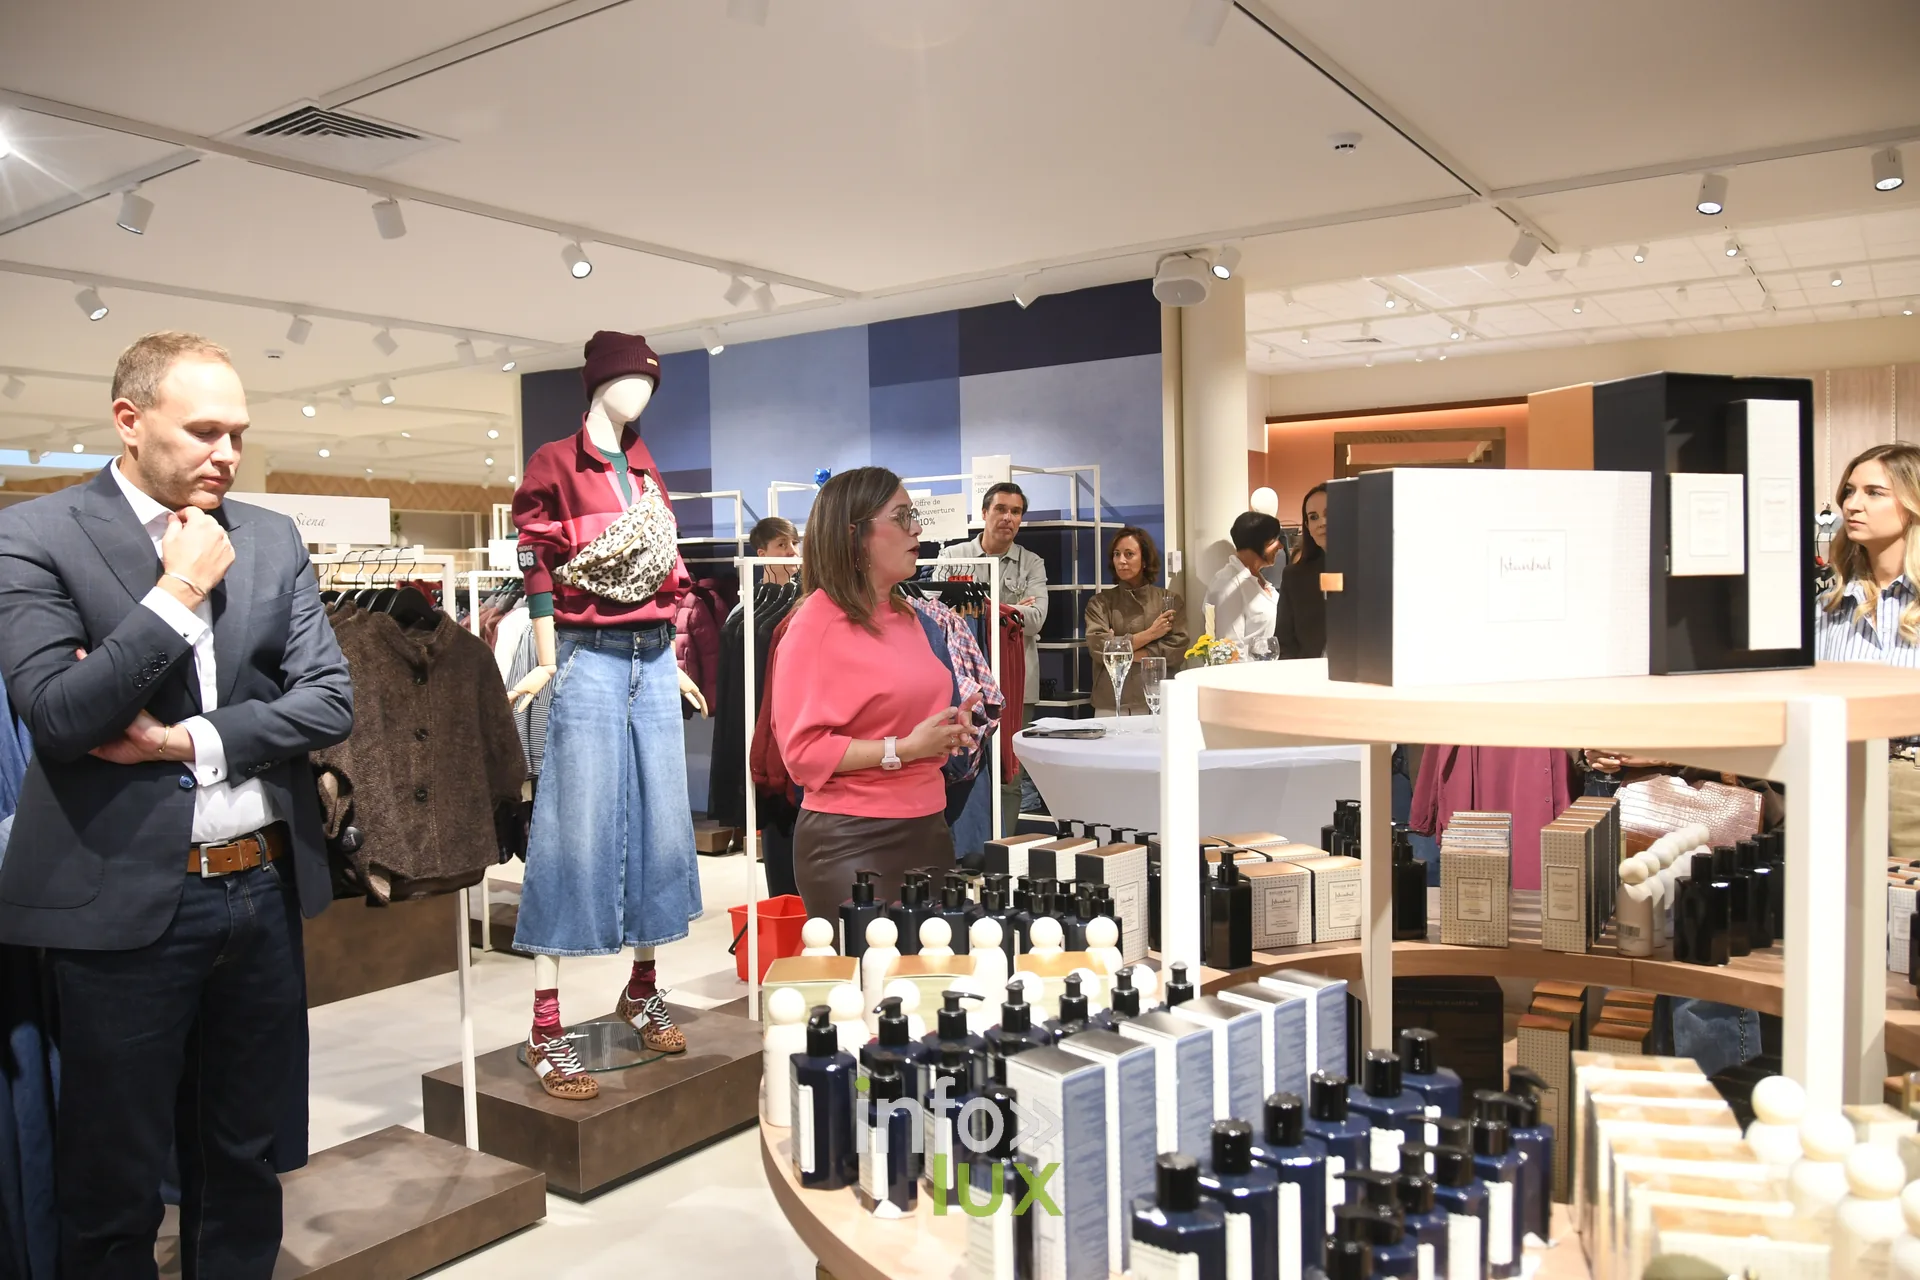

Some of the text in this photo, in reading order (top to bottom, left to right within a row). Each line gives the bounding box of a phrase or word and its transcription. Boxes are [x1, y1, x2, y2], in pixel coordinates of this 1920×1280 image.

[914, 498, 931, 507] Offre
[296, 512, 325, 526] Siena
[518, 551, 535, 567] 96
